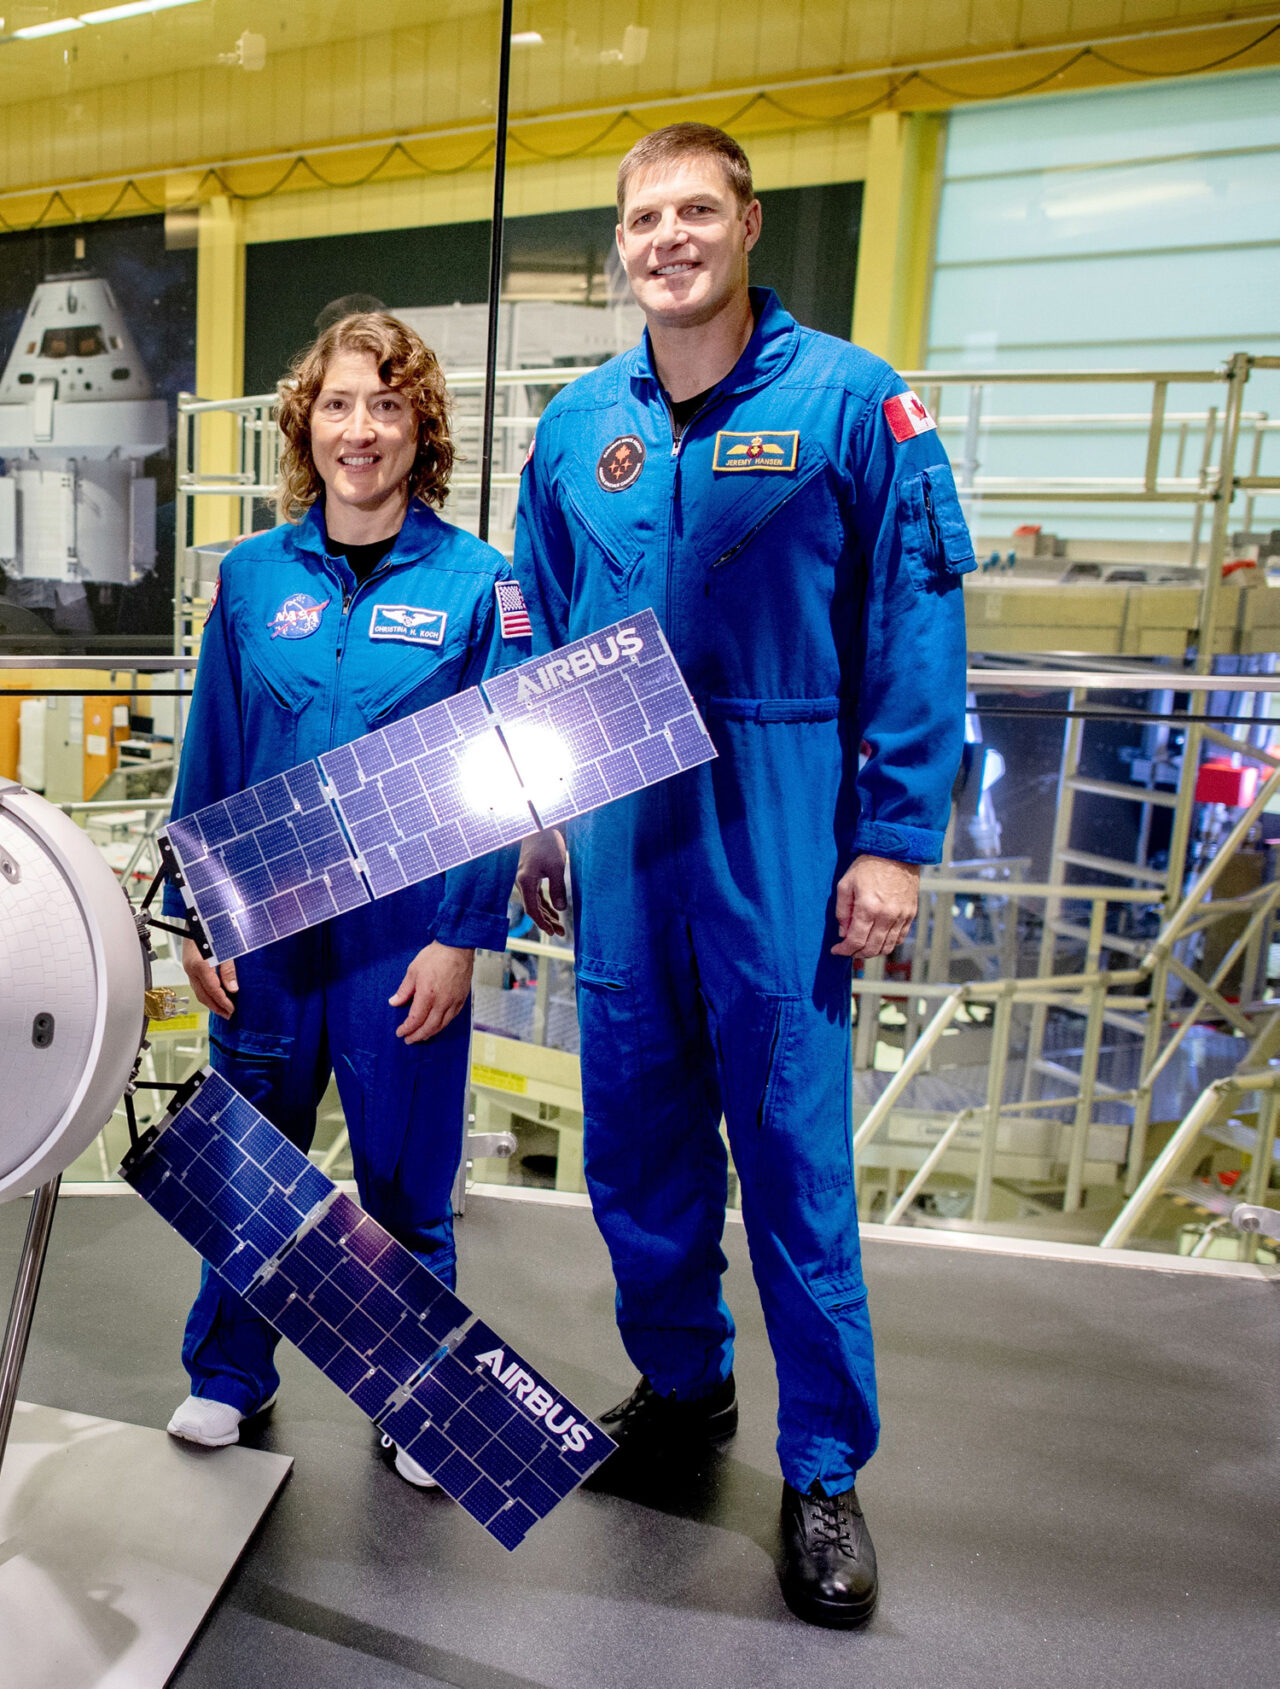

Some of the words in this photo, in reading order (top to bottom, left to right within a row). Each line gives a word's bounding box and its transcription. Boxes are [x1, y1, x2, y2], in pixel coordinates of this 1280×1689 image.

[725, 458, 752, 466] JEREMY
[754, 457, 783, 466] HANSEN
[274, 610, 320, 623] NASA
[374, 625, 408, 634] CHRISTINA
[420, 630, 440, 639] KOCH
[517, 627, 644, 703] AIRBUS
[474, 1348, 593, 1452] AIRBUS
